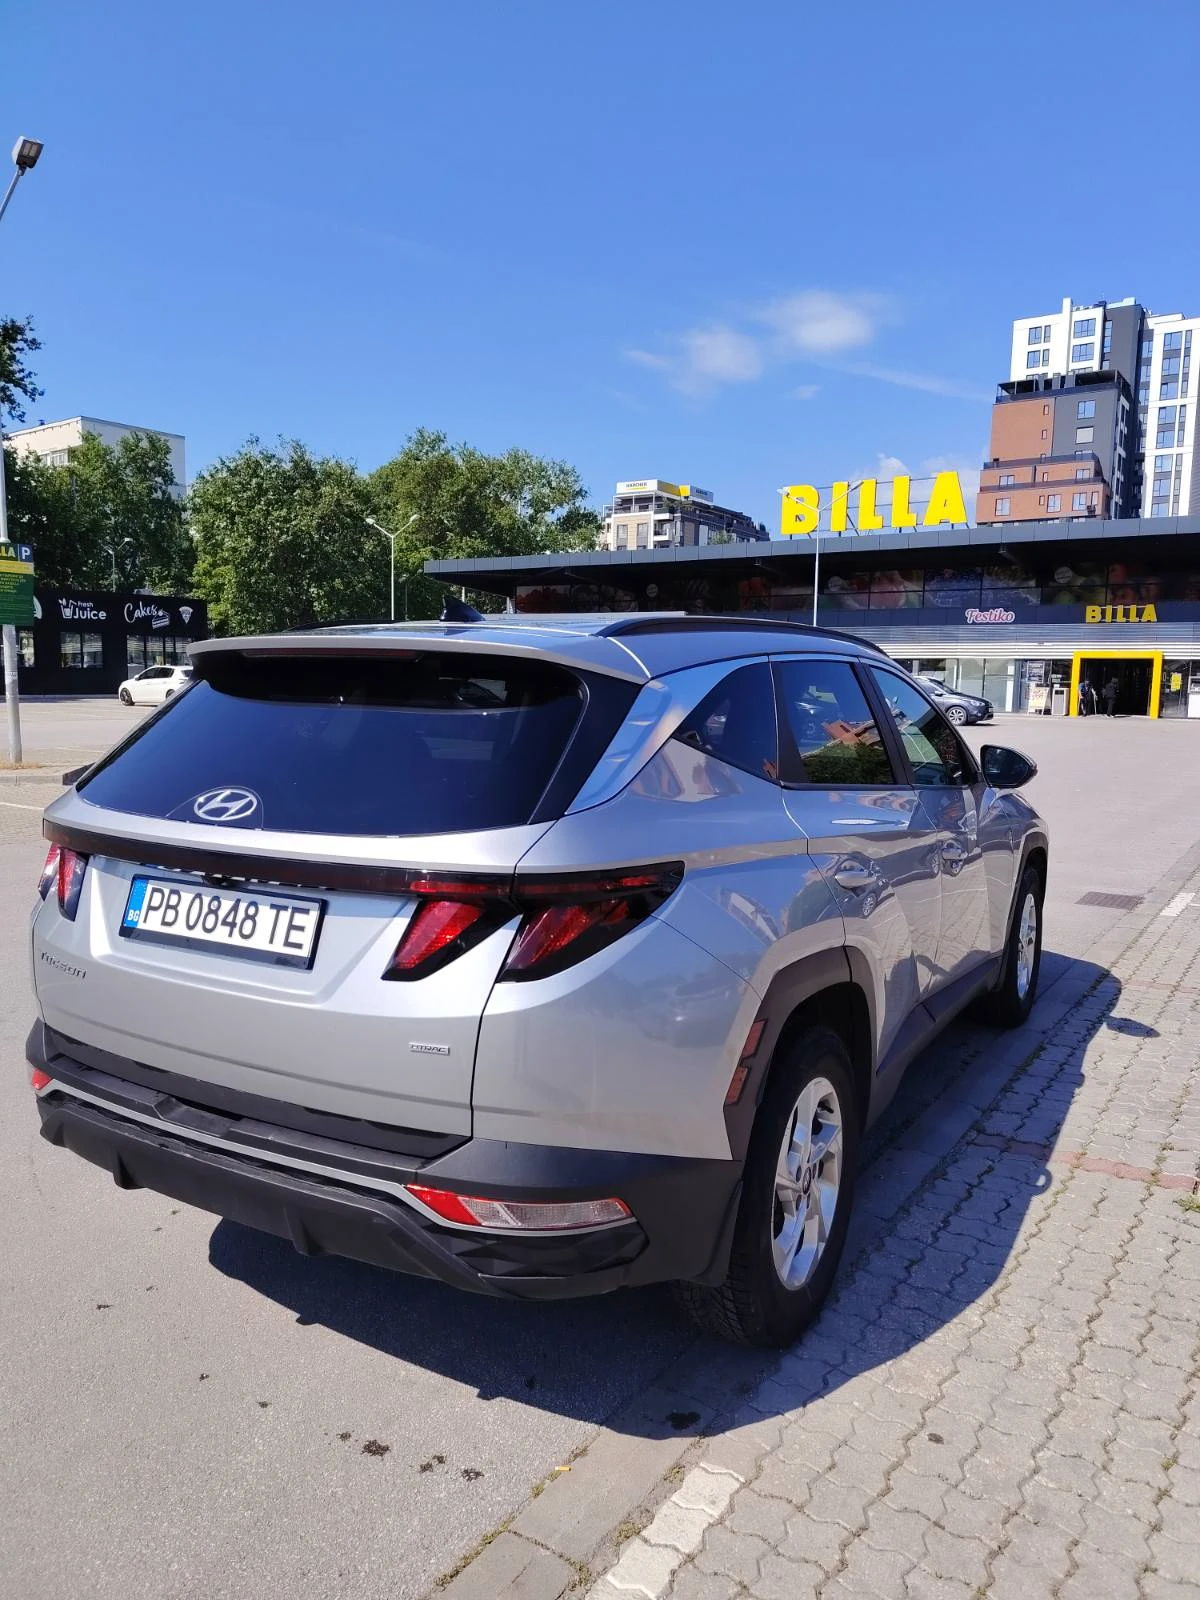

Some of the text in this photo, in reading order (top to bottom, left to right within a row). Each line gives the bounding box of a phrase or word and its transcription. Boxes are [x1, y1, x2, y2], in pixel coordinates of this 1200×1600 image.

[781, 471, 968, 535] BILLA
[0, 545, 16, 558] LA
[21, 546, 31, 560] P
[73, 608, 107, 620] Juice
[123, 601, 158, 623] Cakes
[965, 608, 1015, 624] Festiko
[1085, 604, 1157, 623] BILLA
[127, 910, 140, 921] BG
[143, 887, 311, 950] PB 0848 TE
